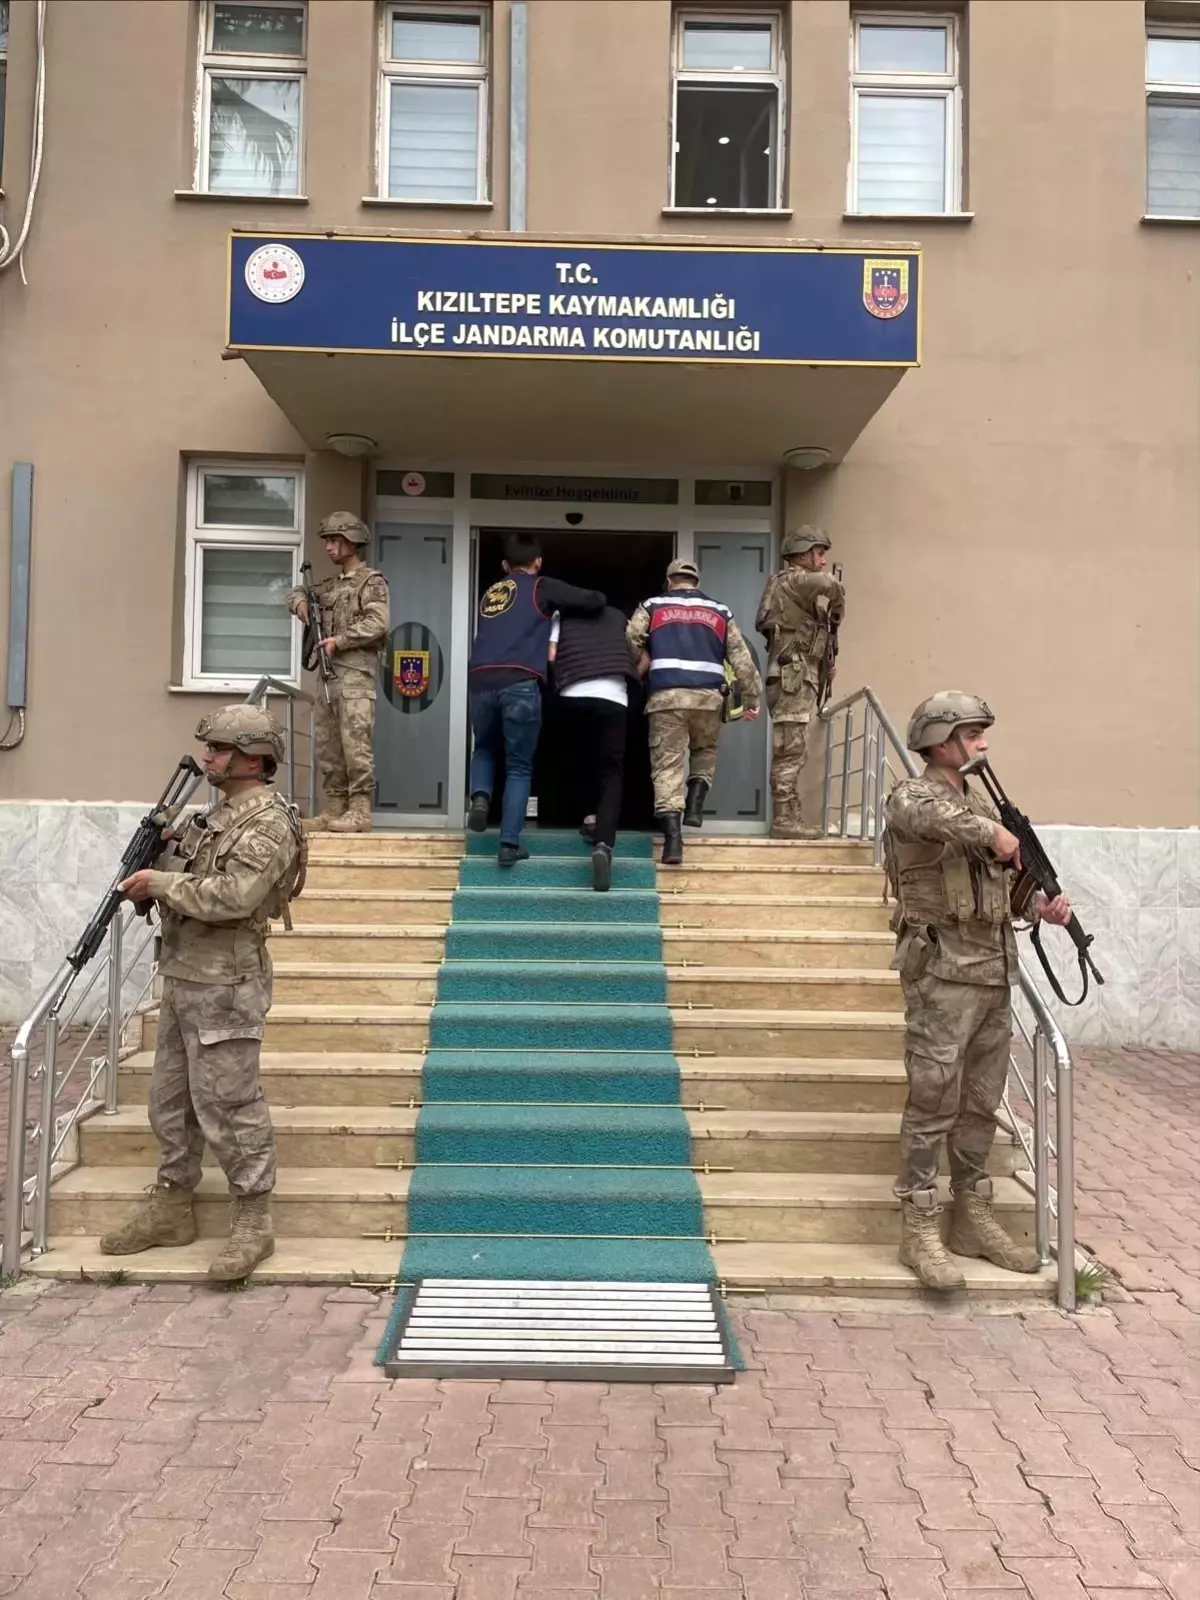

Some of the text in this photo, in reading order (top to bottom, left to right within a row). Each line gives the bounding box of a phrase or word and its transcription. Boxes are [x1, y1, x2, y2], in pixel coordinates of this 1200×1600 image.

[556, 262, 598, 284] T.C.
[417, 290, 736, 319] KIZILTEPE KAYMAKAMLIĞI
[391, 316, 760, 351] İLÇE JANDARMA KOMUTANLIĞI
[505, 484, 640, 501] Evinize Hoşgeldiniz
